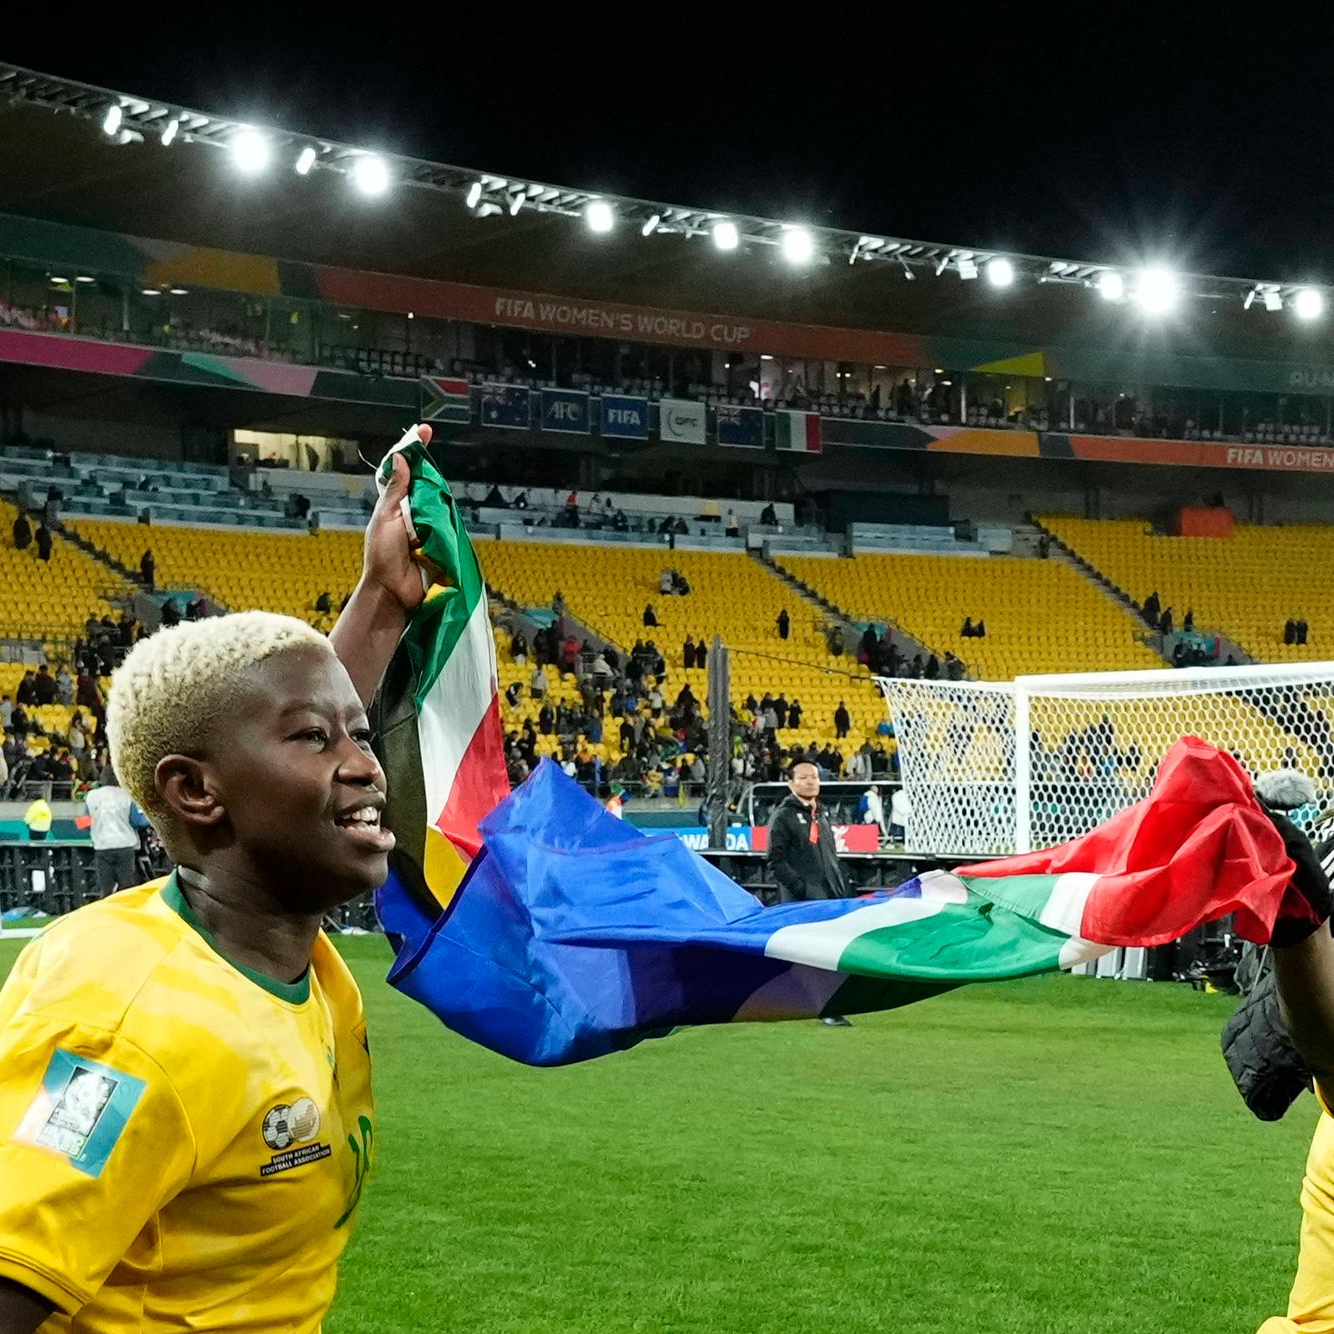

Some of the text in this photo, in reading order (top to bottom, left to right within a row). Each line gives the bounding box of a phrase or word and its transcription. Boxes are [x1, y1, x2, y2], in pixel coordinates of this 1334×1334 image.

[495, 299, 751, 344] FIFA WOMEN'S WORLD CUP
[547, 401, 579, 422] AFC
[607, 408, 641, 426] FIFA
[1226, 448, 1264, 465] FIFA
[683, 833, 749, 850] WADA
[261, 1148, 331, 1175] FOOTBALL ASSOCIATION
[272, 1145, 320, 1165] SOUTH AFRICAN
